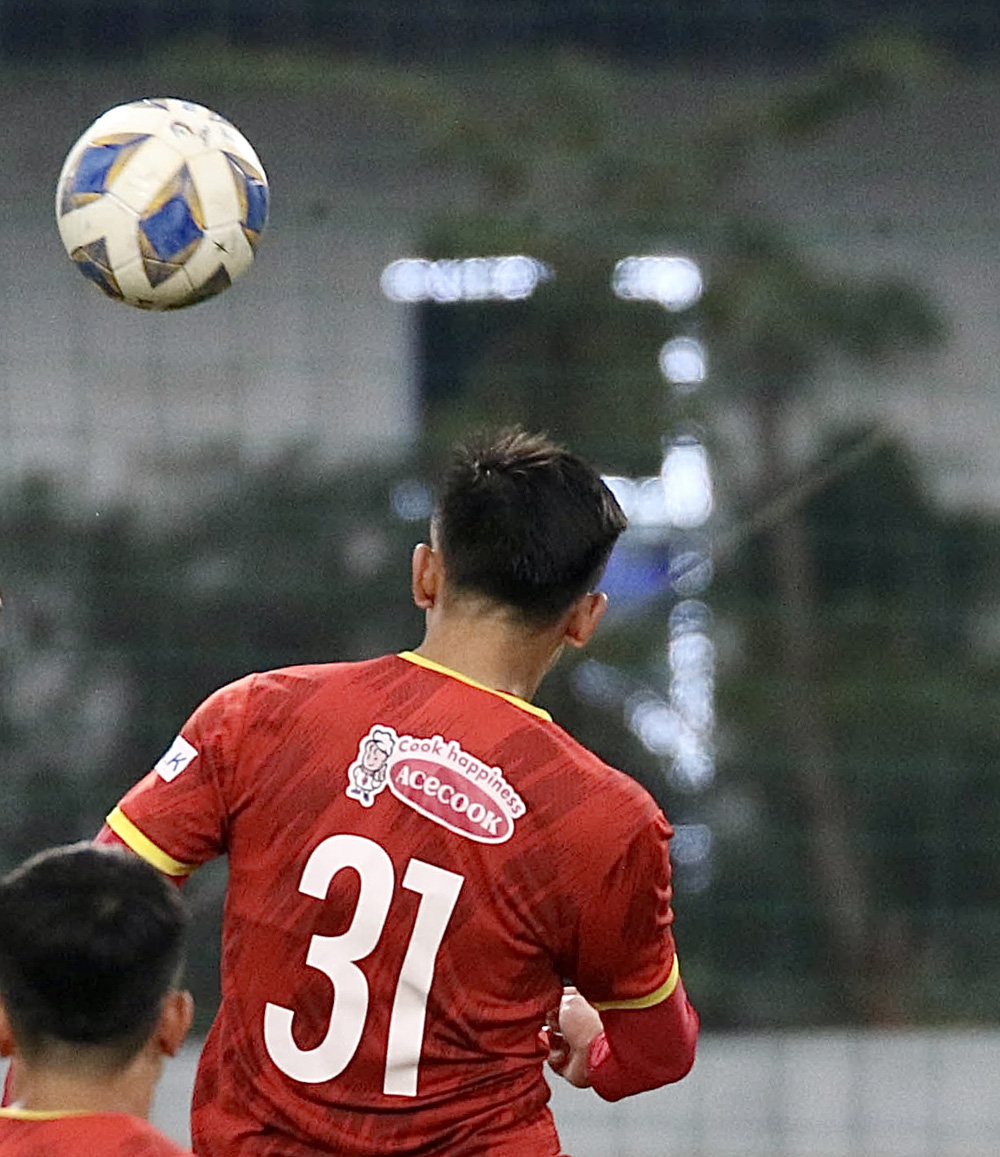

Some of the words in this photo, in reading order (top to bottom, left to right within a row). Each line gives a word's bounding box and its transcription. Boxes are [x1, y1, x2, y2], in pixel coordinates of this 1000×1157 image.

[398, 740, 443, 756] Cook
[447, 746, 522, 815] happiness
[263, 833, 465, 1097] 31
